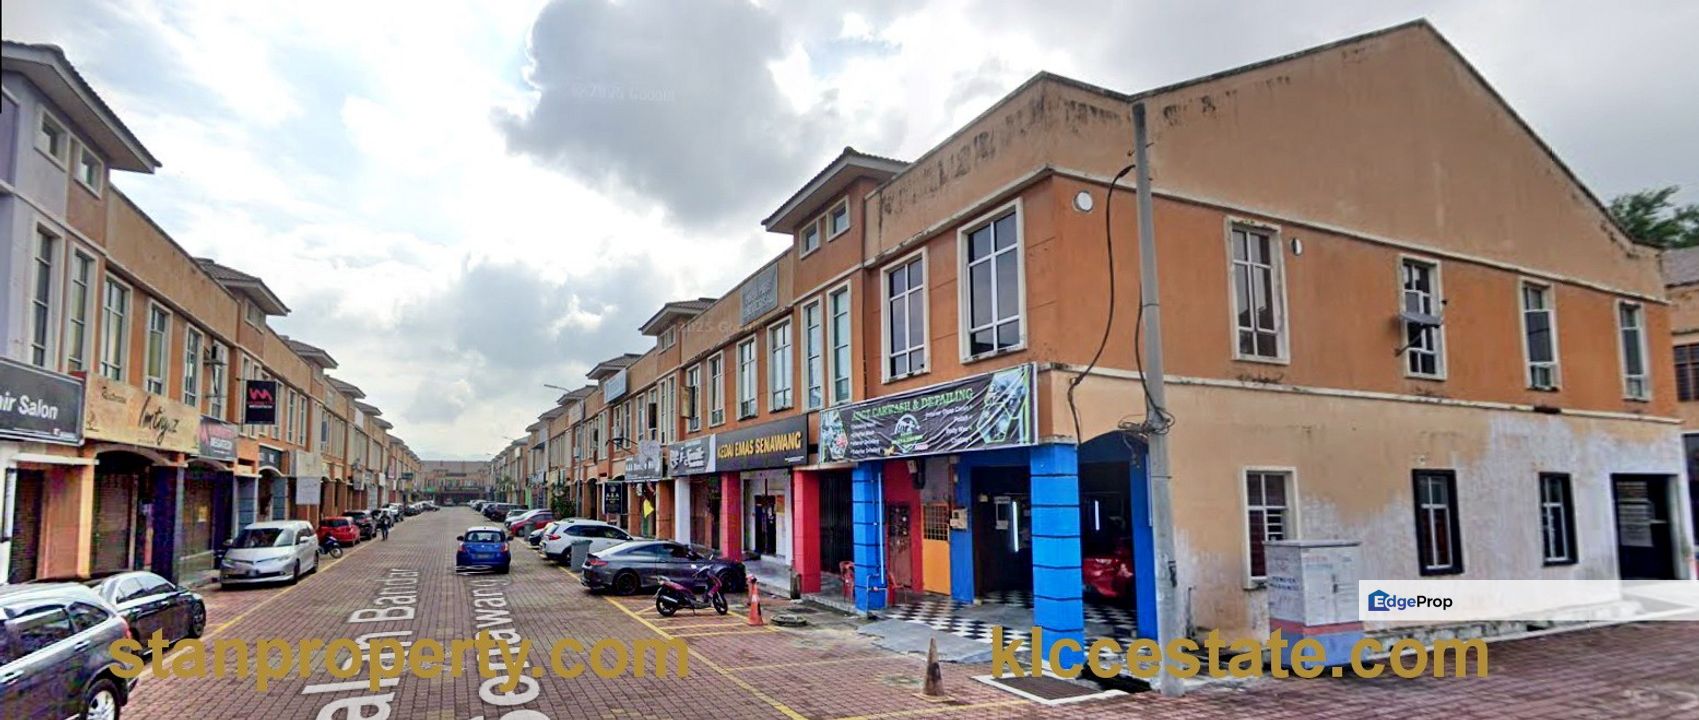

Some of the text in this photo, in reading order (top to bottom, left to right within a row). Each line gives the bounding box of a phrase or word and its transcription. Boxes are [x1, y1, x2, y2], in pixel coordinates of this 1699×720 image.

[18, 395, 59, 420] Salon
[921, 387, 974, 409] DETAILING
[735, 439, 754, 456] EMAS
[755, 431, 802, 454] SENAWANG
